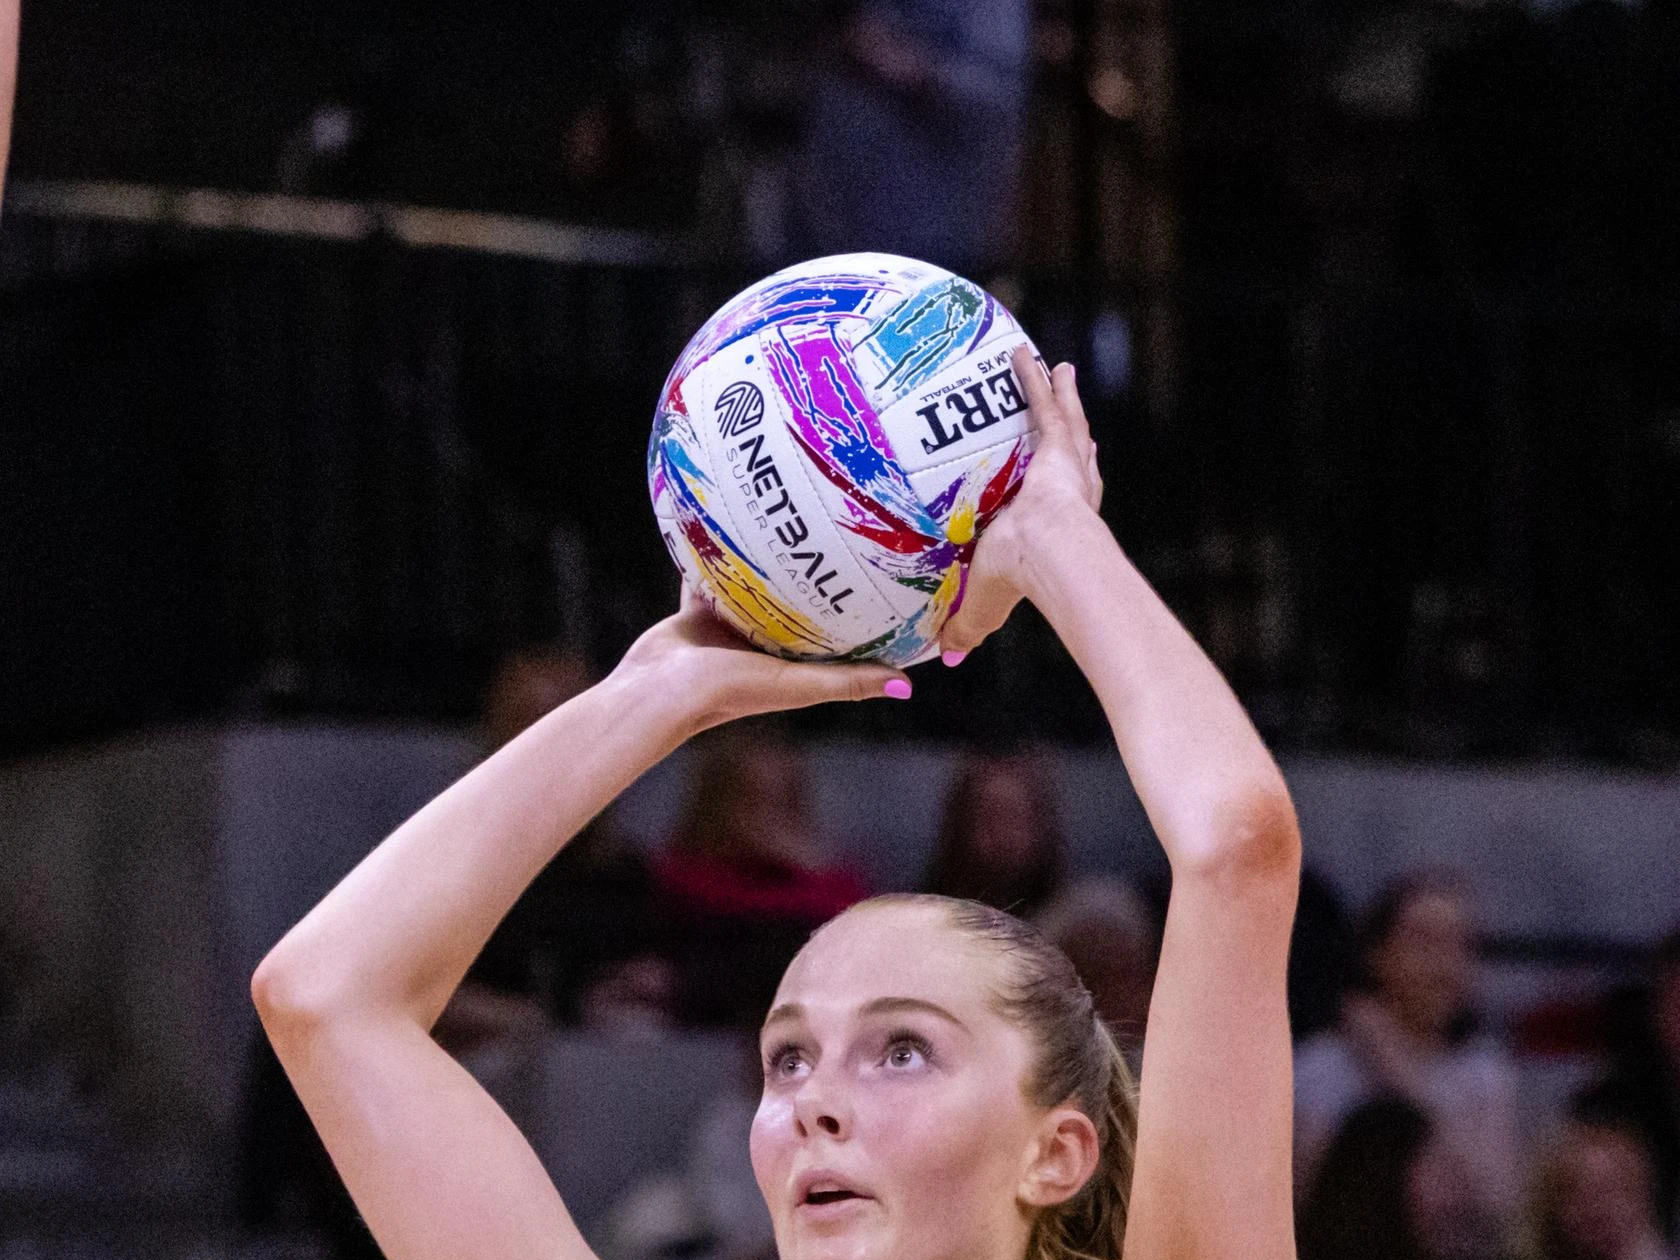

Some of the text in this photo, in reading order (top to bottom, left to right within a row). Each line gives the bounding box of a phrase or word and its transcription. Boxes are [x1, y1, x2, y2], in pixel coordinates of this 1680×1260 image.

[915, 367, 1029, 455] ERT
[919, 376, 972, 402] NETBALL
[726, 447, 834, 621] SUPER LEAGUE
[738, 434, 854, 615] NETBALL
